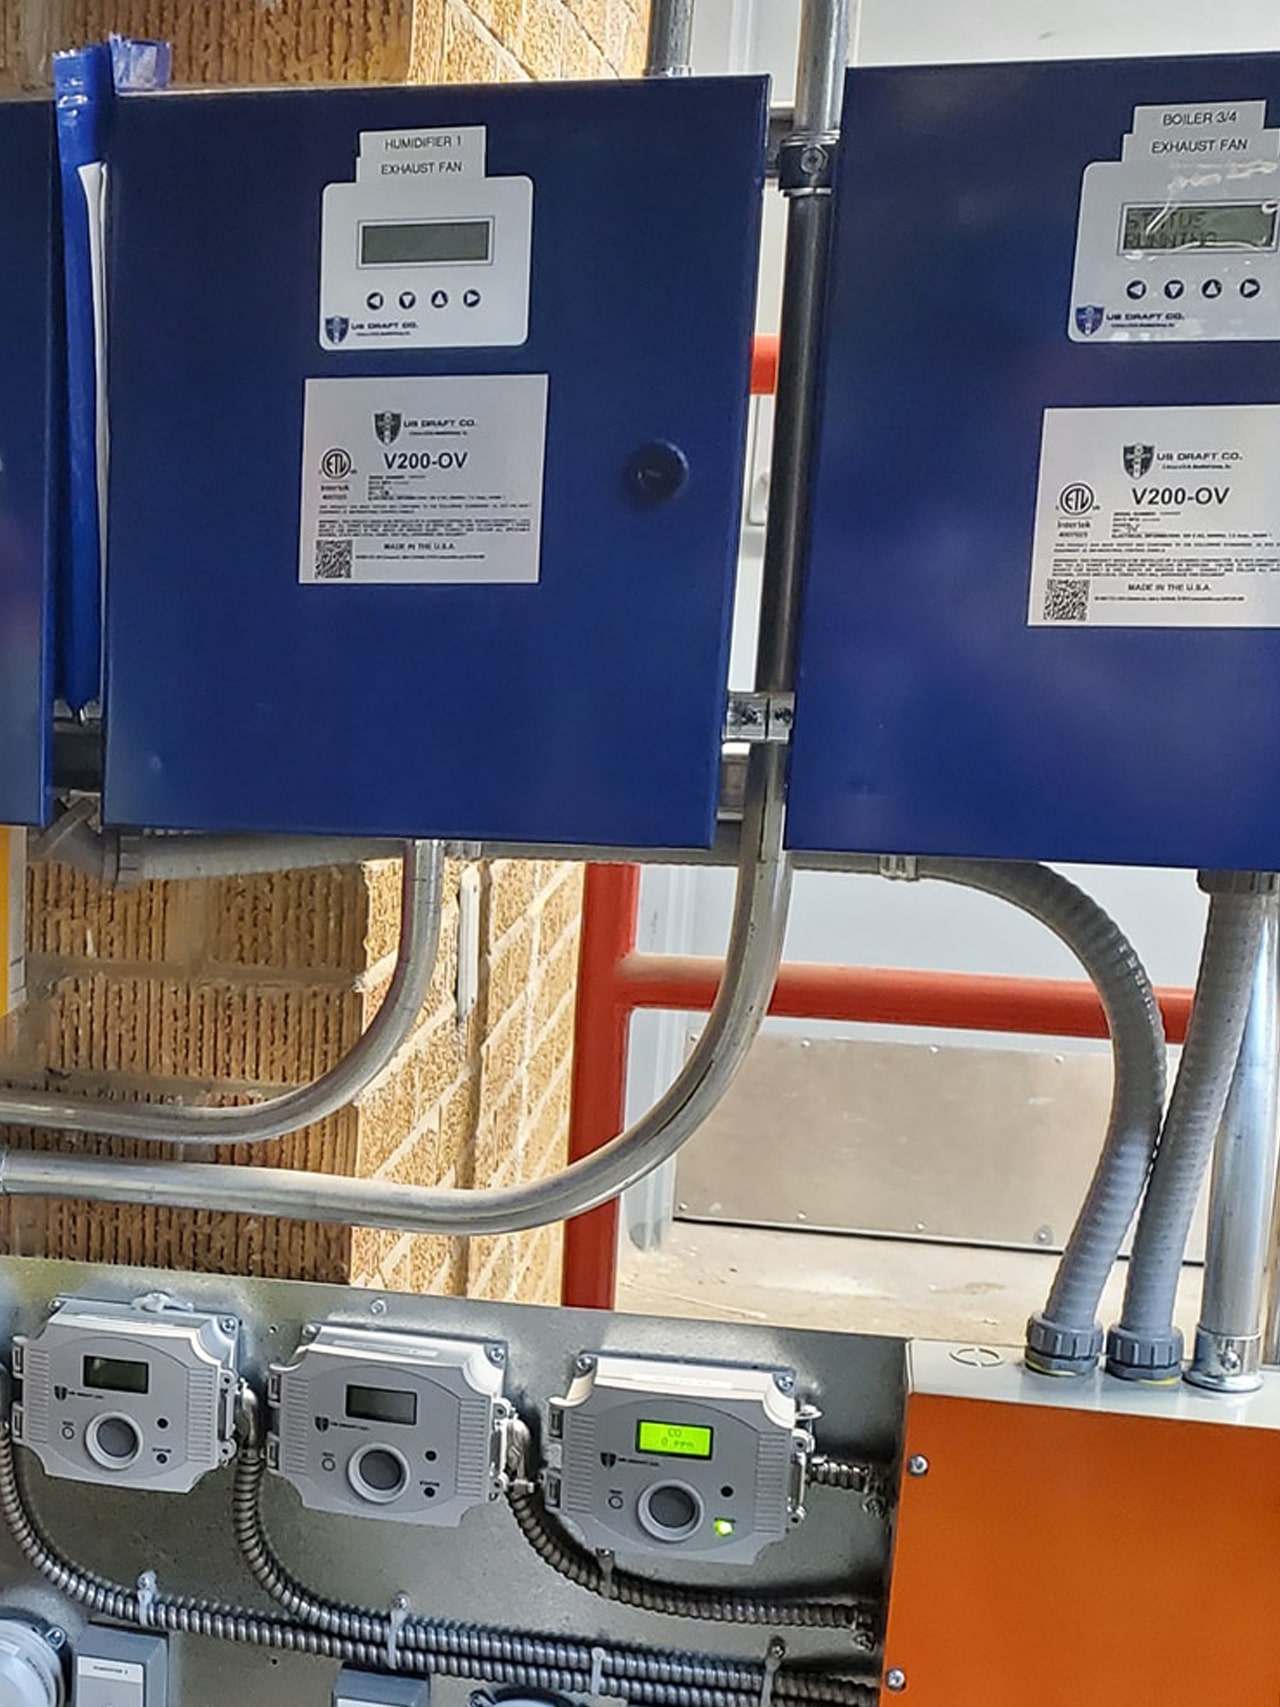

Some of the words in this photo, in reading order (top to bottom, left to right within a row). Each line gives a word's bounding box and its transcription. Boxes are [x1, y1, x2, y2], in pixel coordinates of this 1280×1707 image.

[1163, 112, 1213, 127] BOILER
[1216, 111, 1237, 124] 3/4
[384, 136, 452, 150] HUMIDIFIER
[456, 135, 462, 147] 1
[1151, 140, 1215, 154] EXHAUST
[1219, 138, 1248, 151] FAN
[381, 163, 434, 176] EXHAUST
[438, 161, 463, 173] FAN
[1127, 211, 1207, 229] STTUS
[1106, 313, 1122, 321] US
[1124, 313, 1163, 321] DRAFT
[351, 322, 365, 330] US
[367, 322, 399, 330] DRAFT
[403, 419, 419, 428] US
[421, 419, 456, 428] DRAFT
[384, 451, 468, 470] V200-OV
[1156, 452, 1173, 461] US
[1177, 452, 1218, 461] DRAFT
[1221, 452, 1243, 461] CO.
[1132, 487, 1230, 506] V200-OV
[1128, 583, 1152, 591] MADE
[1155, 583, 1165, 591] IN
[1167, 583, 1183, 591] THE
[667, 1427, 682, 1438] CO
